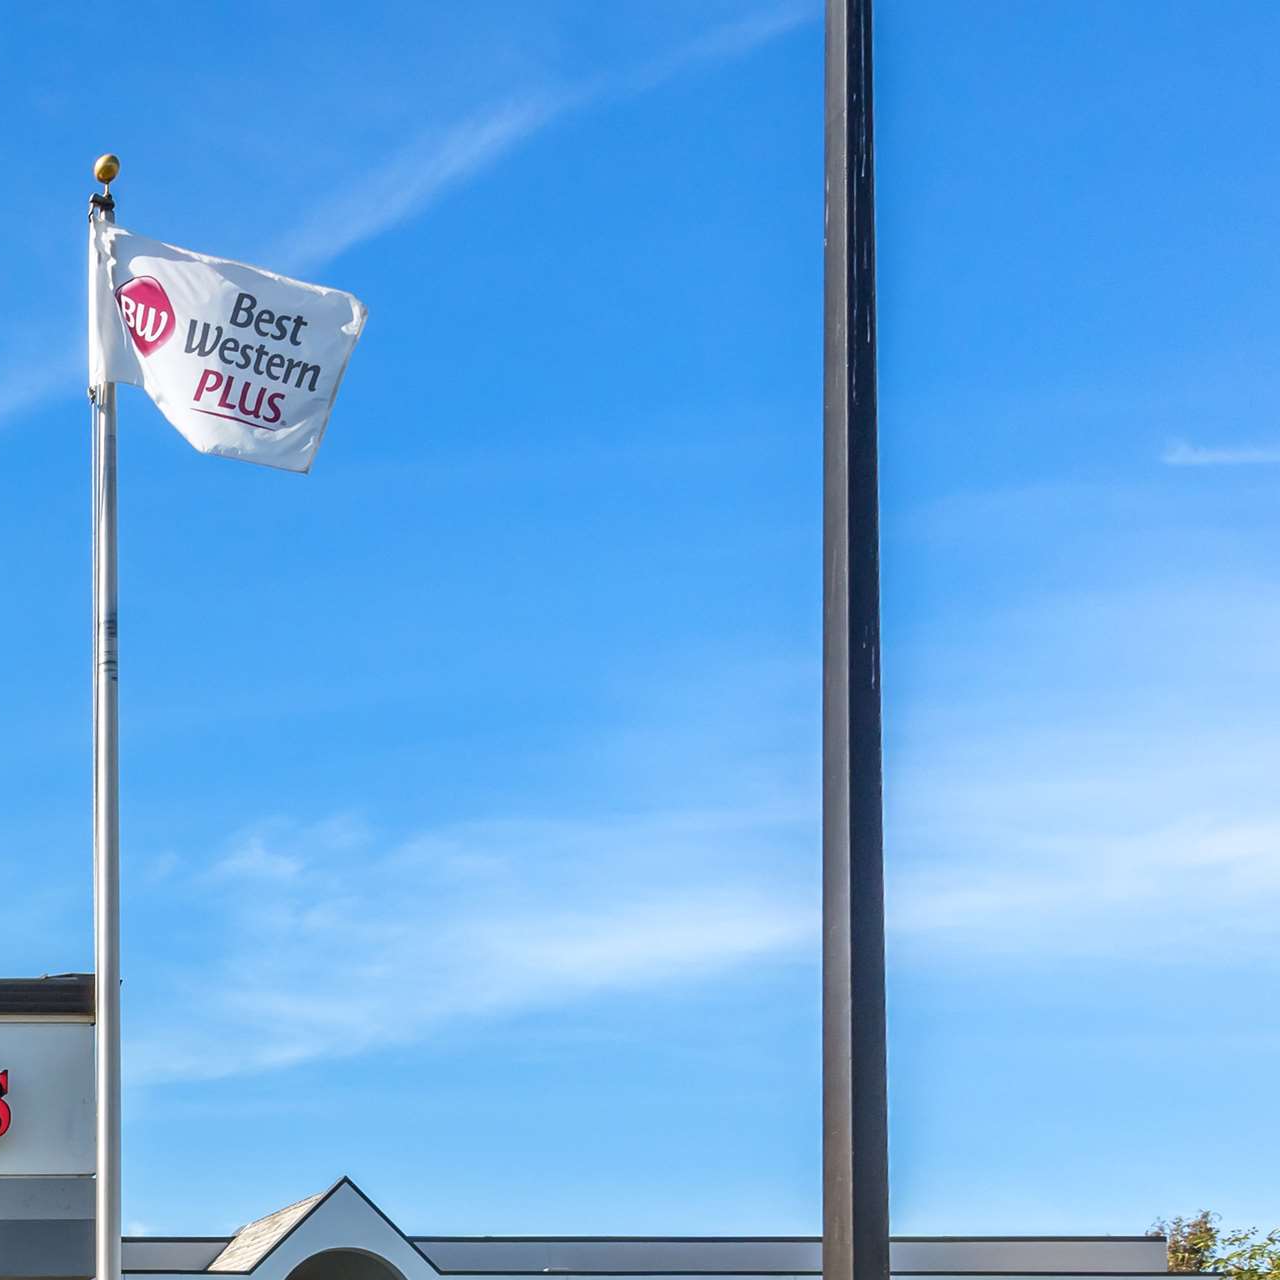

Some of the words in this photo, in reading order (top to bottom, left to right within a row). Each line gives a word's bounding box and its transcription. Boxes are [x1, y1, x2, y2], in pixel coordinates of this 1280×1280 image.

[121, 297, 168, 342] BW
[231, 292, 308, 346] Best
[184, 319, 321, 392] Western
[193, 369, 286, 424] PLUS
